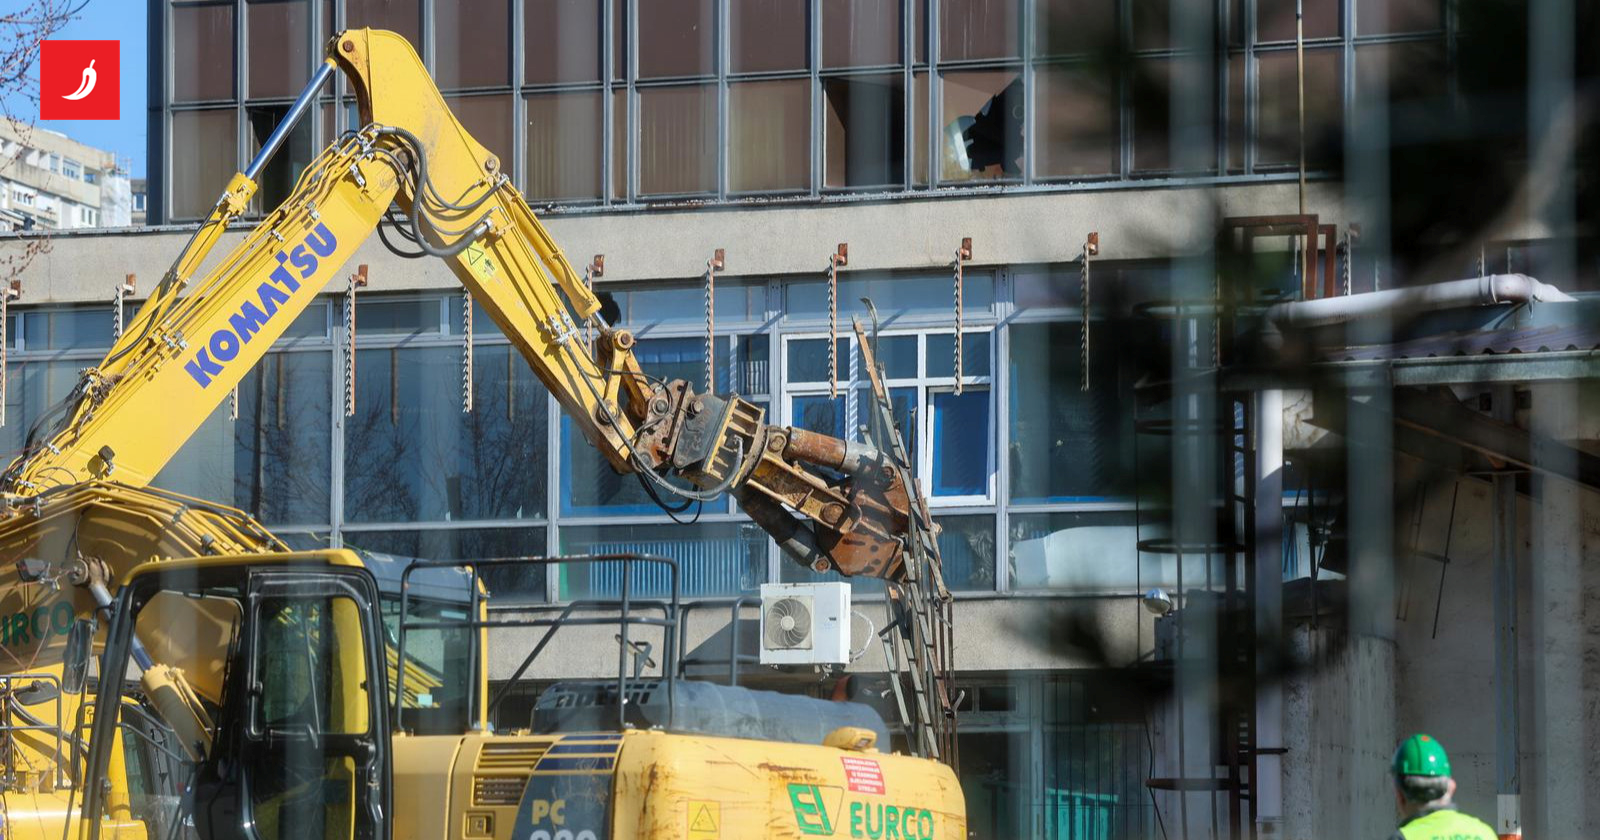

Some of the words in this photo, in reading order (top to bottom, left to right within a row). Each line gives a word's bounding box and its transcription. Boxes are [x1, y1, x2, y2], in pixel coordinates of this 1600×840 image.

[184, 222, 338, 389] KOMATSU
[532, 799, 566, 825] PC
[850, 801, 934, 840] EURCO
